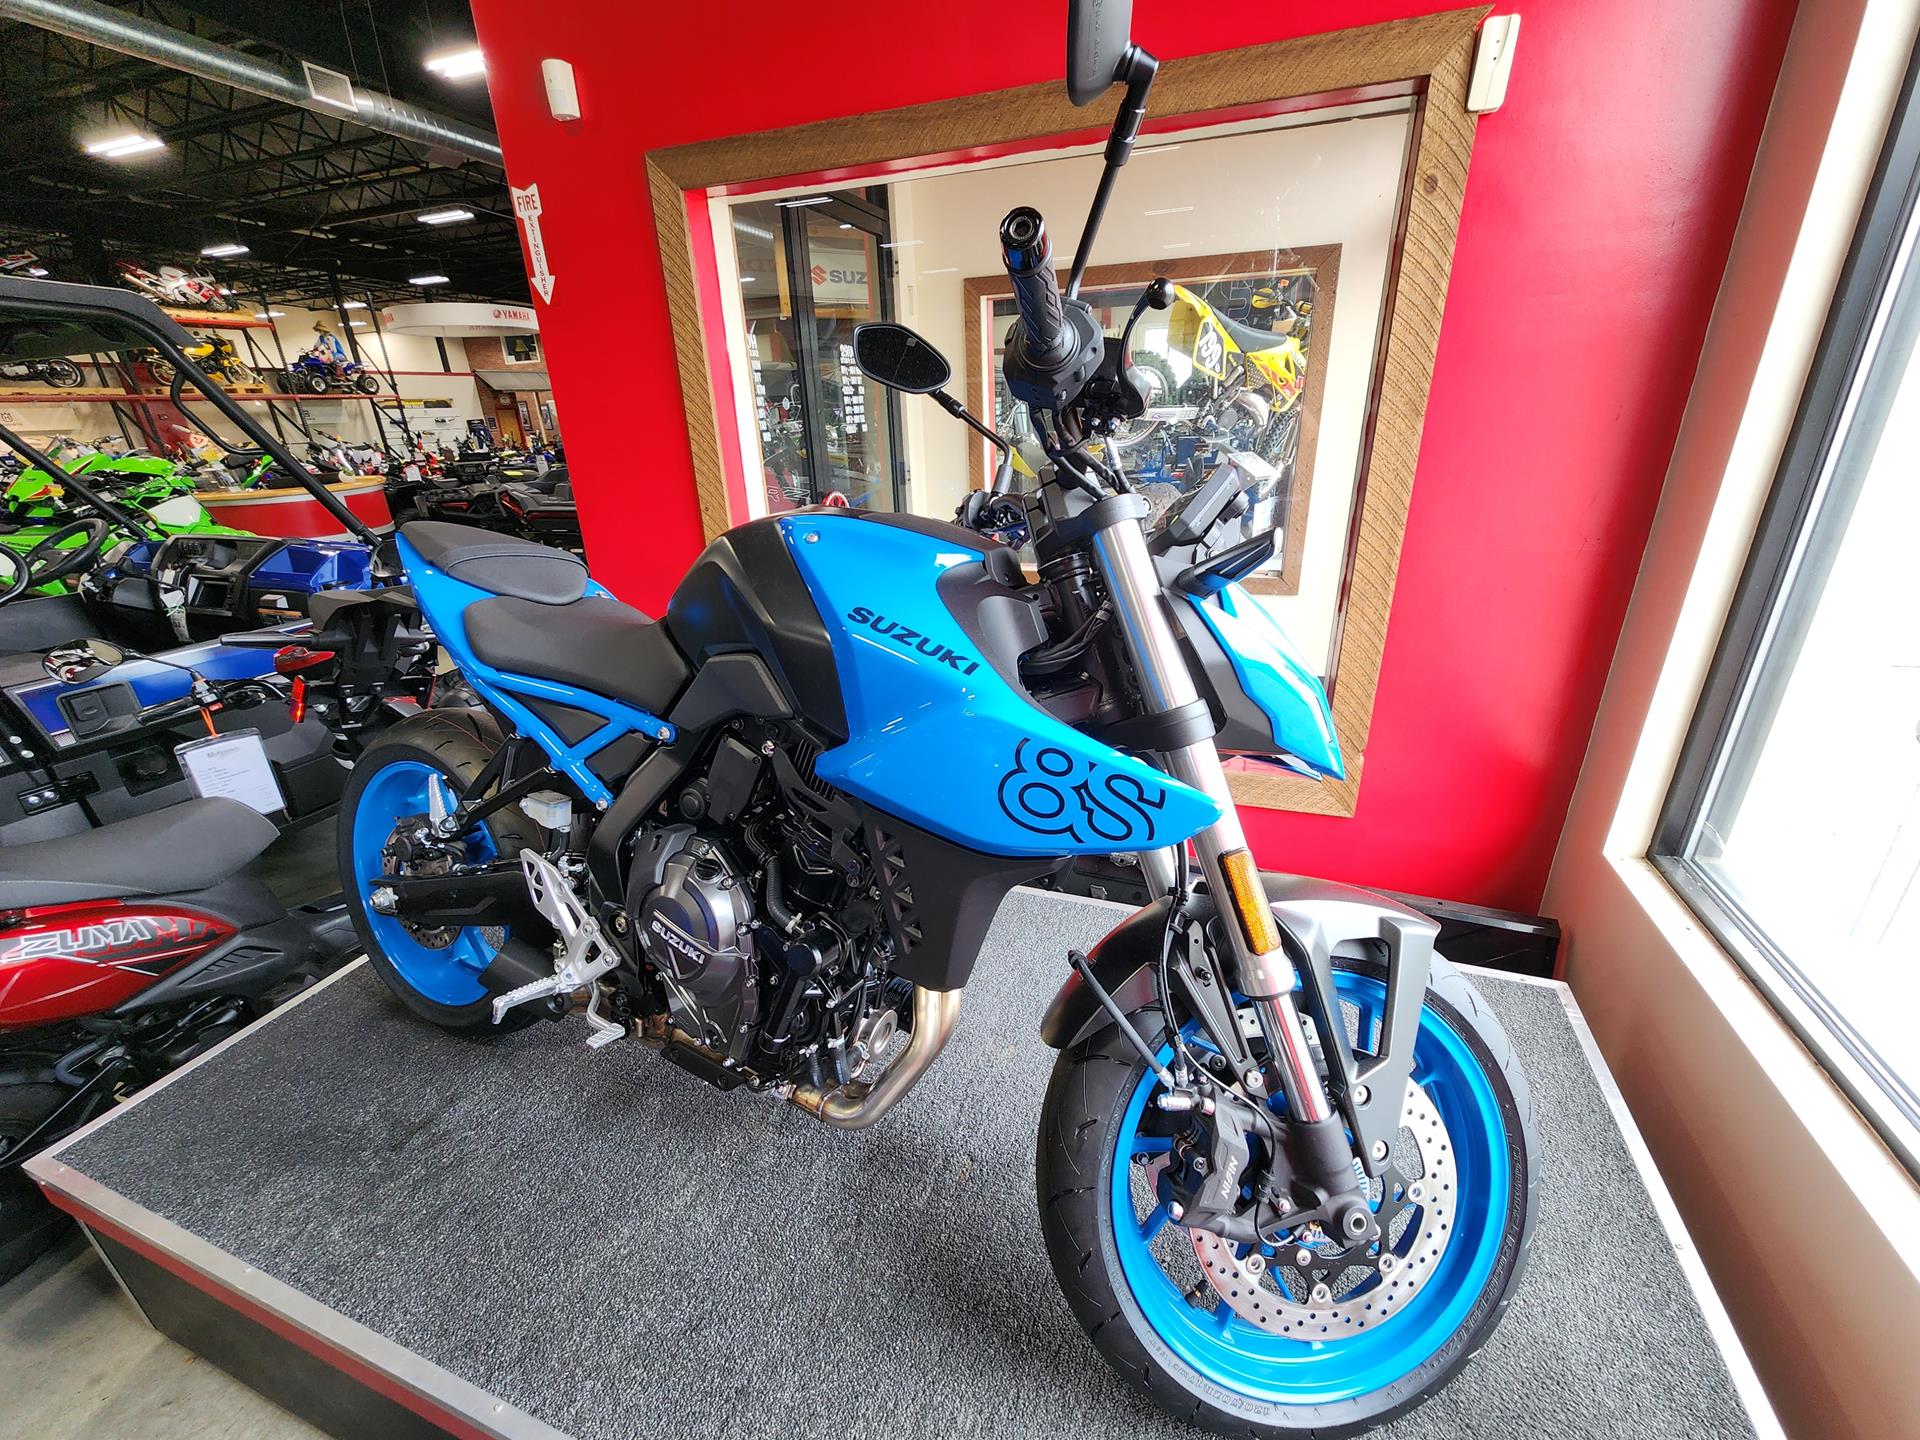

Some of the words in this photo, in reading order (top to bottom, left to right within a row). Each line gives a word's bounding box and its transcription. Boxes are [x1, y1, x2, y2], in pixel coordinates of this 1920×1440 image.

[516, 194, 538, 212] FIRE
[527, 215, 549, 297] EXTINGUISHER
[829, 269, 867, 284] SUZ
[502, 309, 531, 321] YAMAHA
[847, 606, 980, 676] SUZUKI
[14, 918, 152, 958] ZUMA
[651, 920, 705, 965] SUZUKI
[1221, 1155, 1238, 1200] NISSIN
